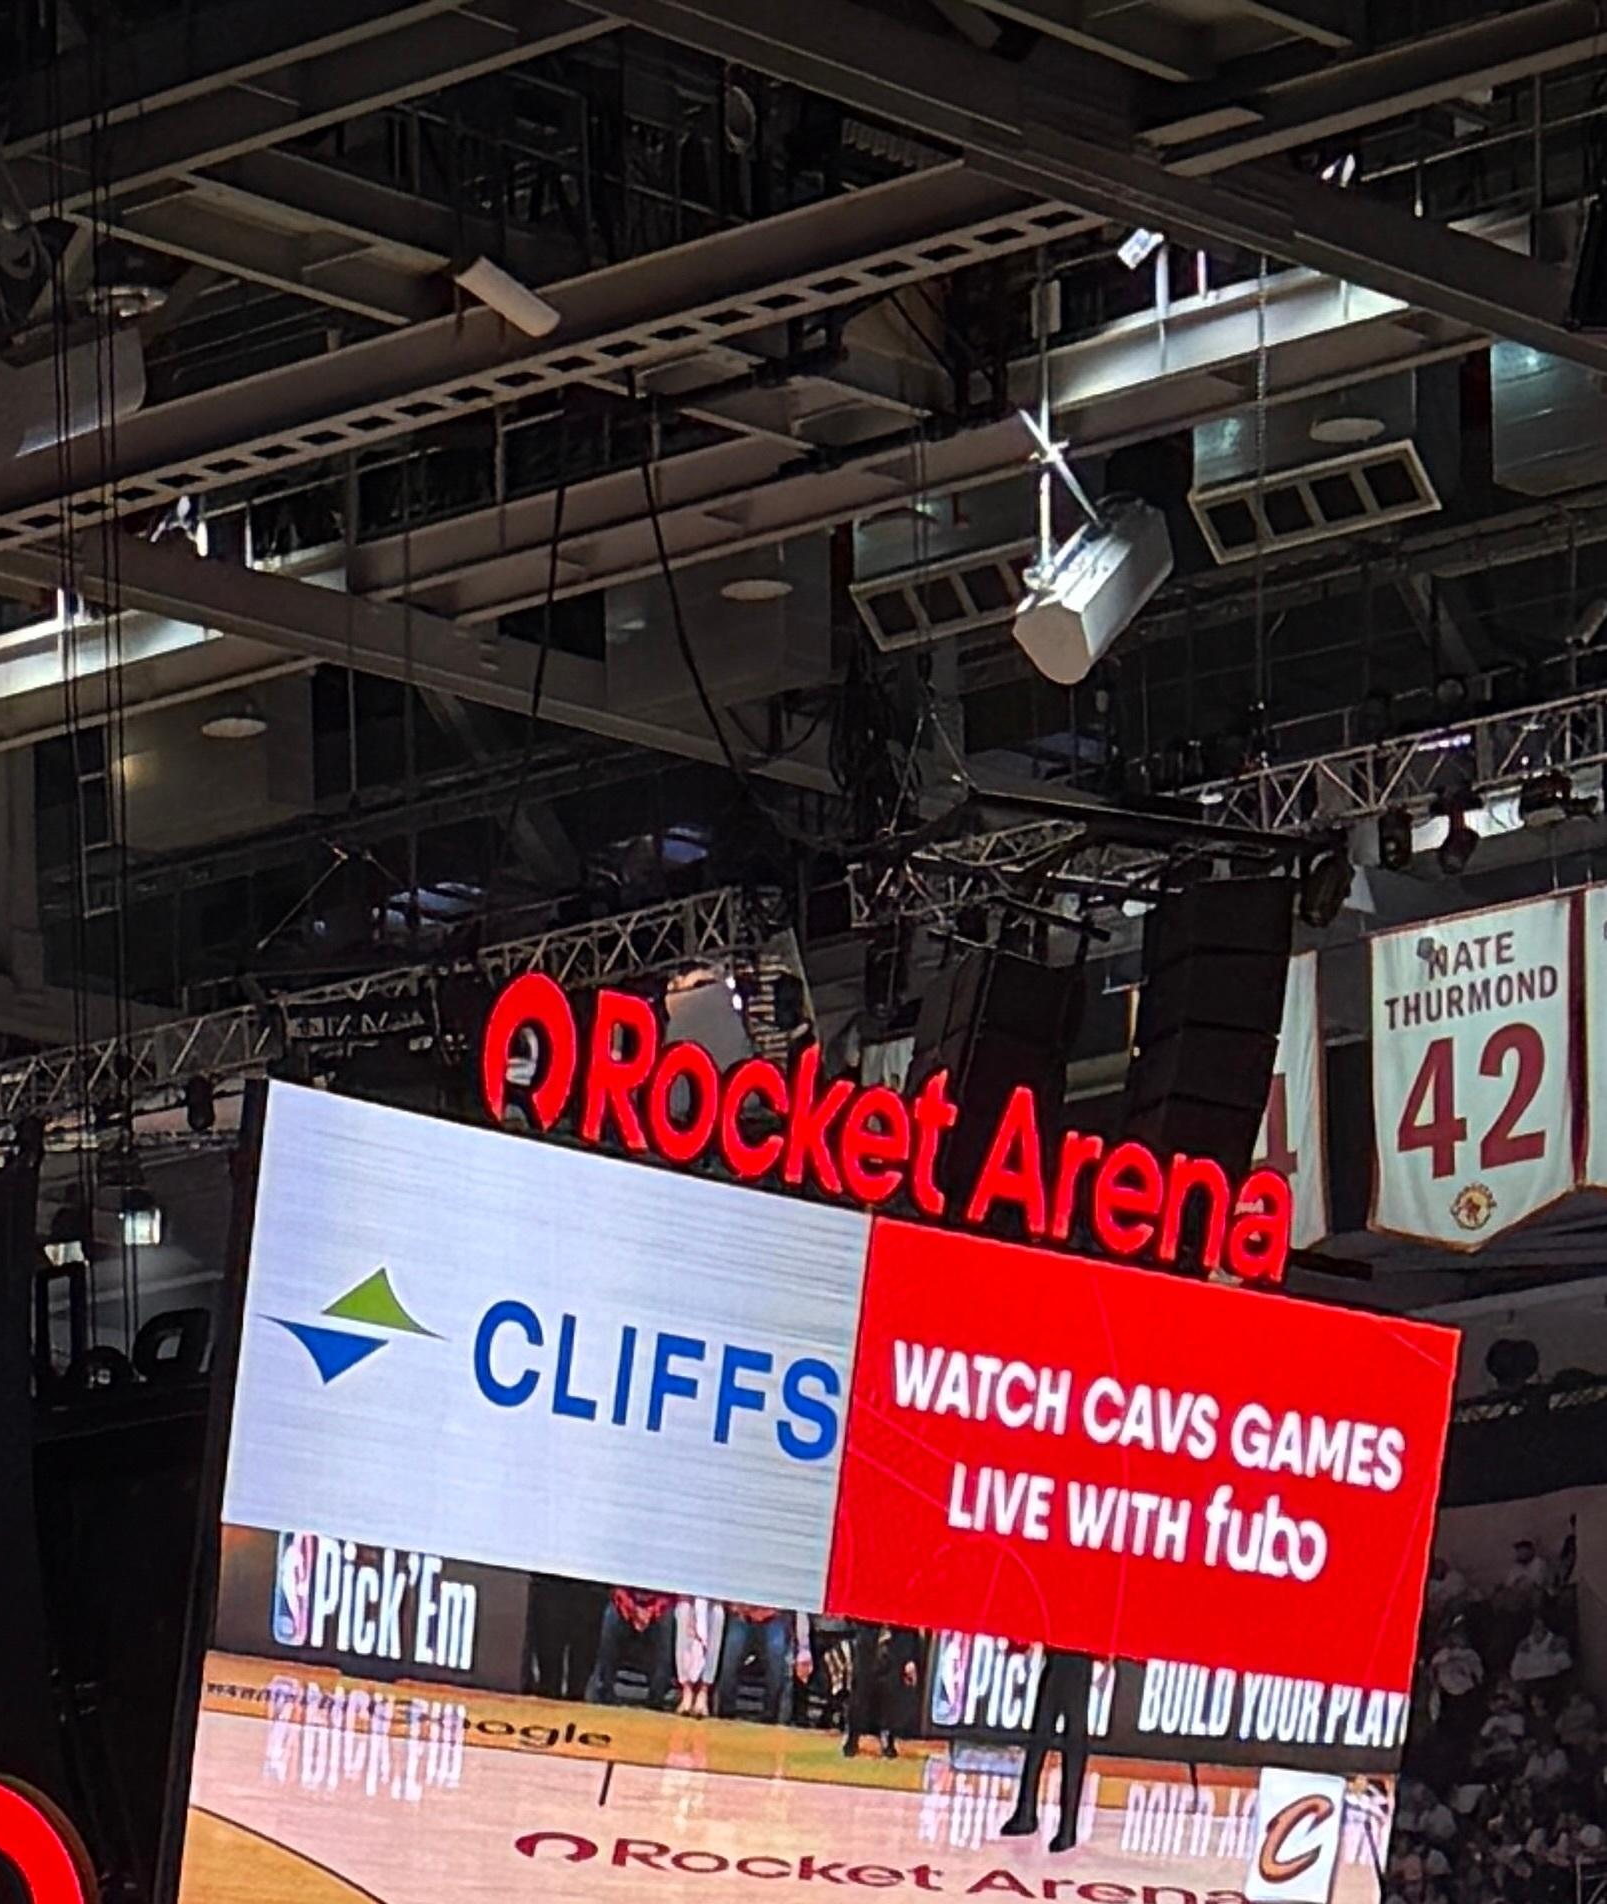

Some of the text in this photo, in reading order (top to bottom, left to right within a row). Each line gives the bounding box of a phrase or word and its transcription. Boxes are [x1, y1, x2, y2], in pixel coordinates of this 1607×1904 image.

[1384, 965, 1558, 1030] THURMOND
[1428, 931, 1515, 981] NATE
[579, 989, 959, 1215] Rocket
[969, 1087, 1293, 1283] Arena
[1398, 1022, 1546, 1179] 42
[474, 1300, 841, 1460] CLIFFS
[892, 1339, 1405, 1491] WATCH CAVS GAMES
[948, 1463, 1326, 1581] LIVE WITH fubo
[311, 1538, 477, 1670] Pick'Em
[612, 1838, 943, 1893] Rocket
